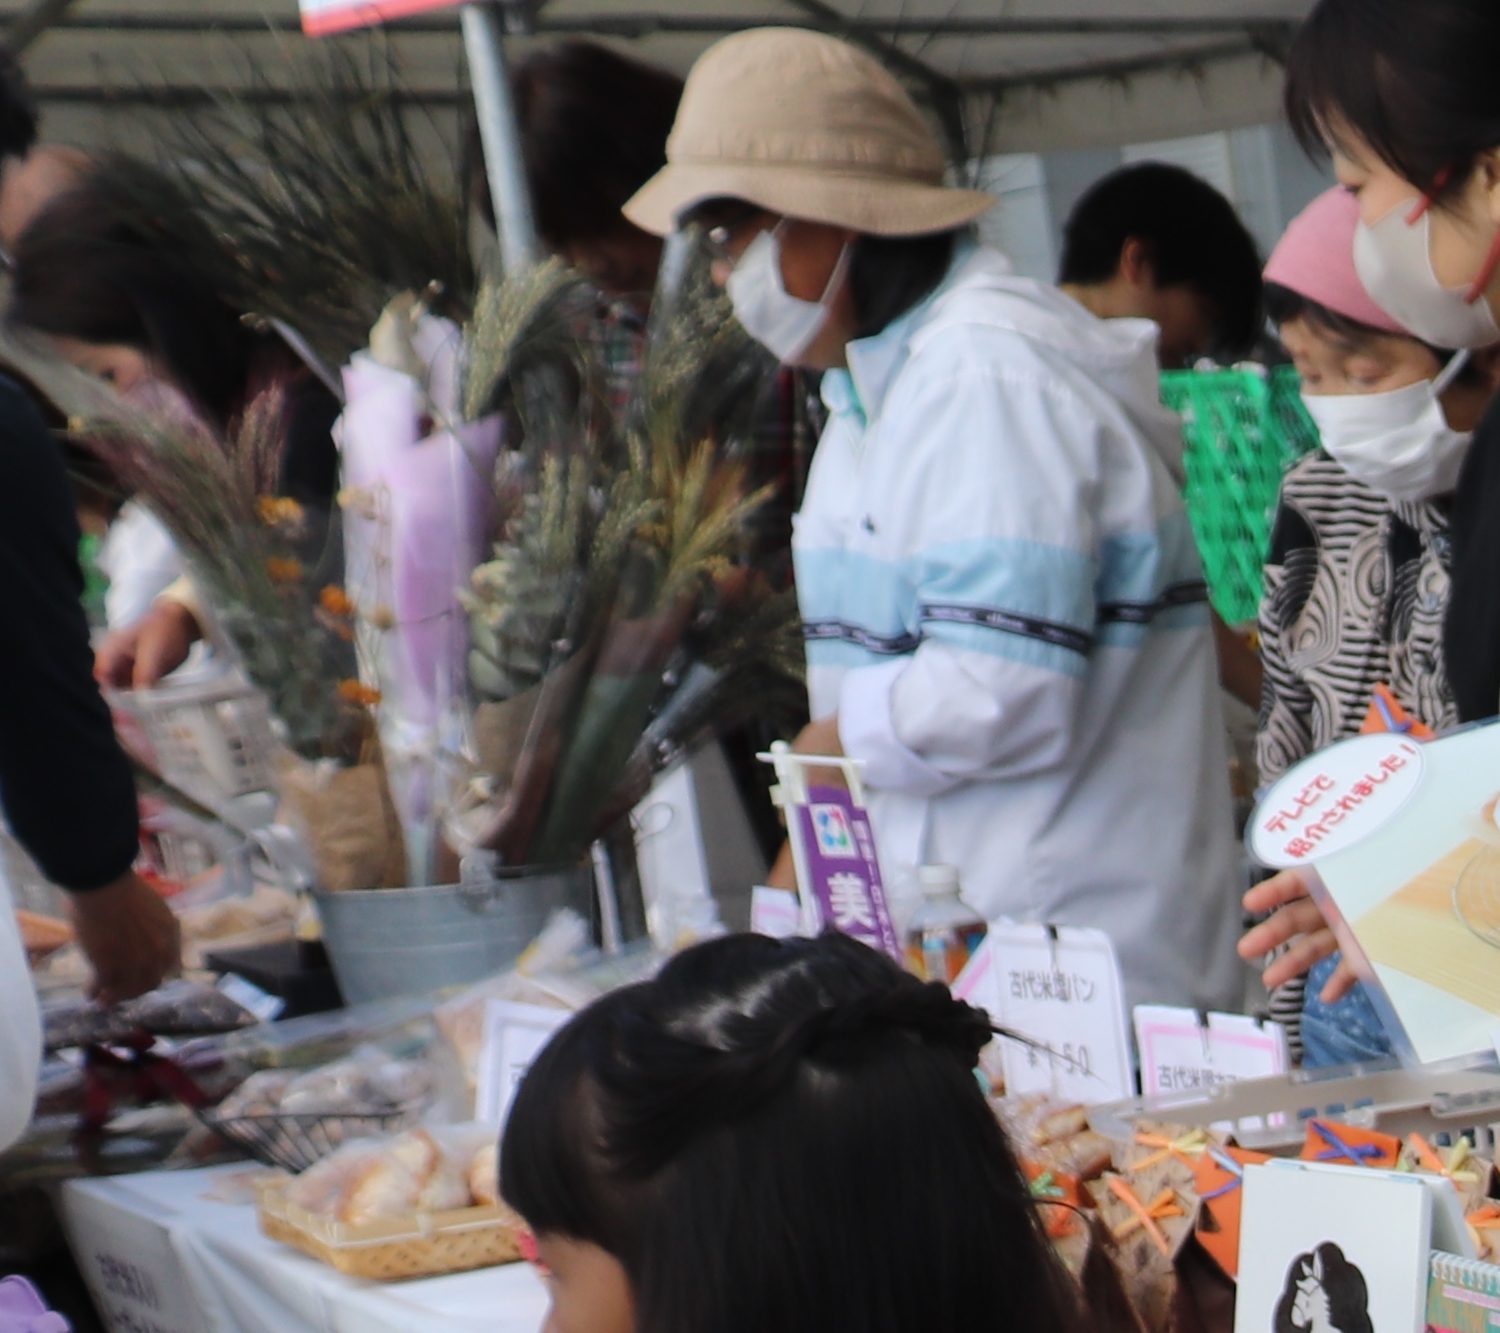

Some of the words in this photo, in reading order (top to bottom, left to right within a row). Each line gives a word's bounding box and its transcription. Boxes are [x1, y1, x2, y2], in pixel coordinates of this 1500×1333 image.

[1263, 774, 1336, 837] テレビで
[827, 873, 884, 940] 美
